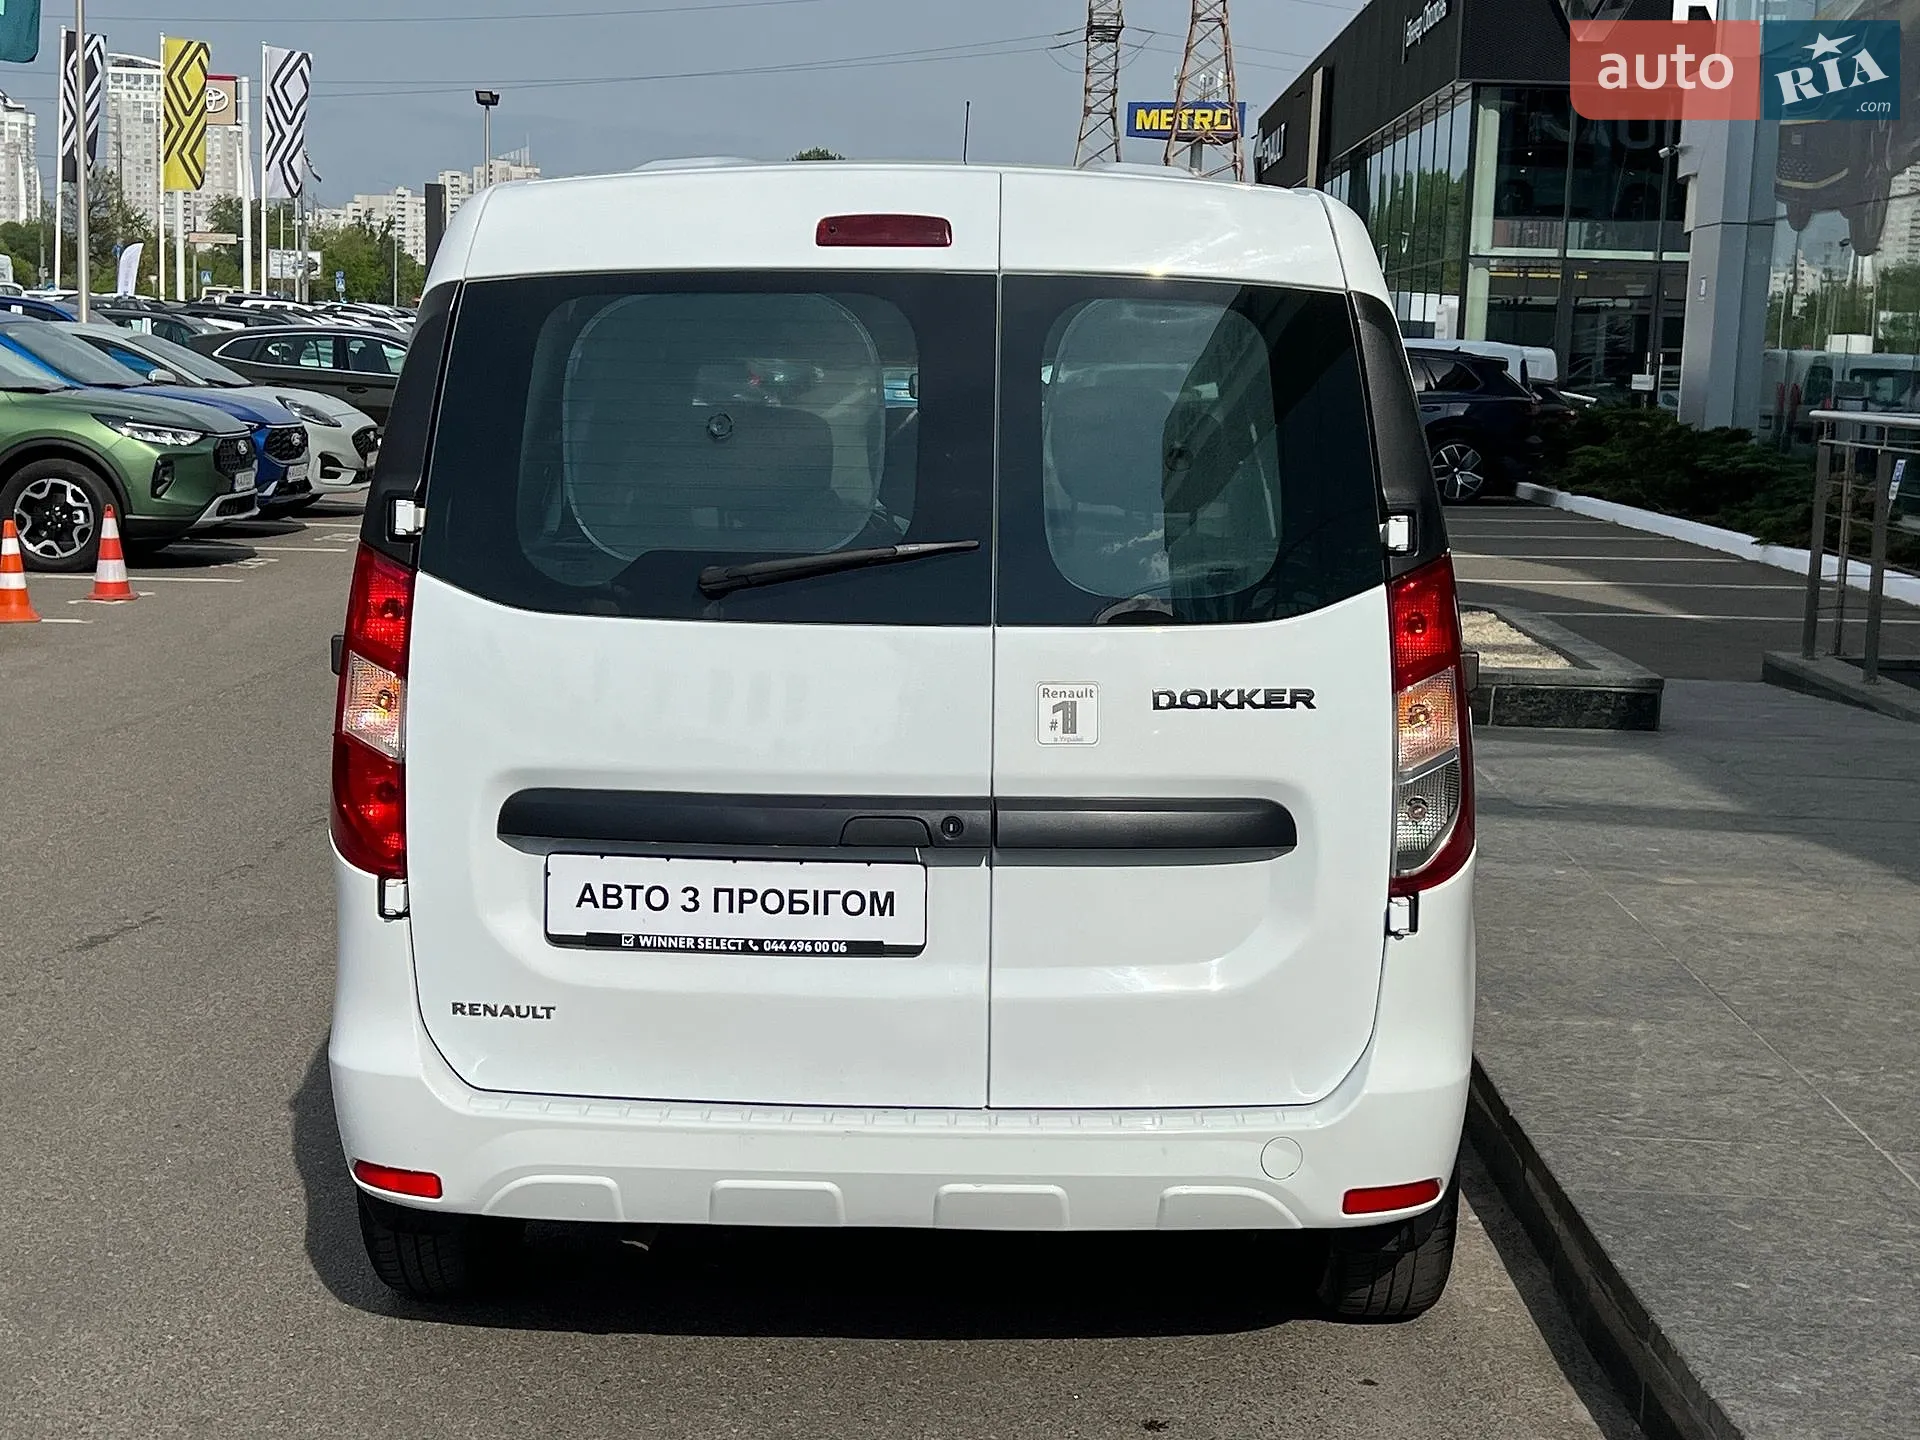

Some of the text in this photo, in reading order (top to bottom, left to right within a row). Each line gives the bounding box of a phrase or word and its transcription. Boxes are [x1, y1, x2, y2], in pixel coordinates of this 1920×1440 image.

[1136, 108, 1233, 130] METRO
[1042, 687, 1094, 699] Renault
[1151, 688, 1317, 710] DOKKER
[576, 882, 669, 912] АВТО
[713, 887, 895, 917] ПРОБІГОМ
[639, 935, 848, 953] WINNER SELECT 044 496 00 06
[451, 1002, 556, 1020] RENAULT
